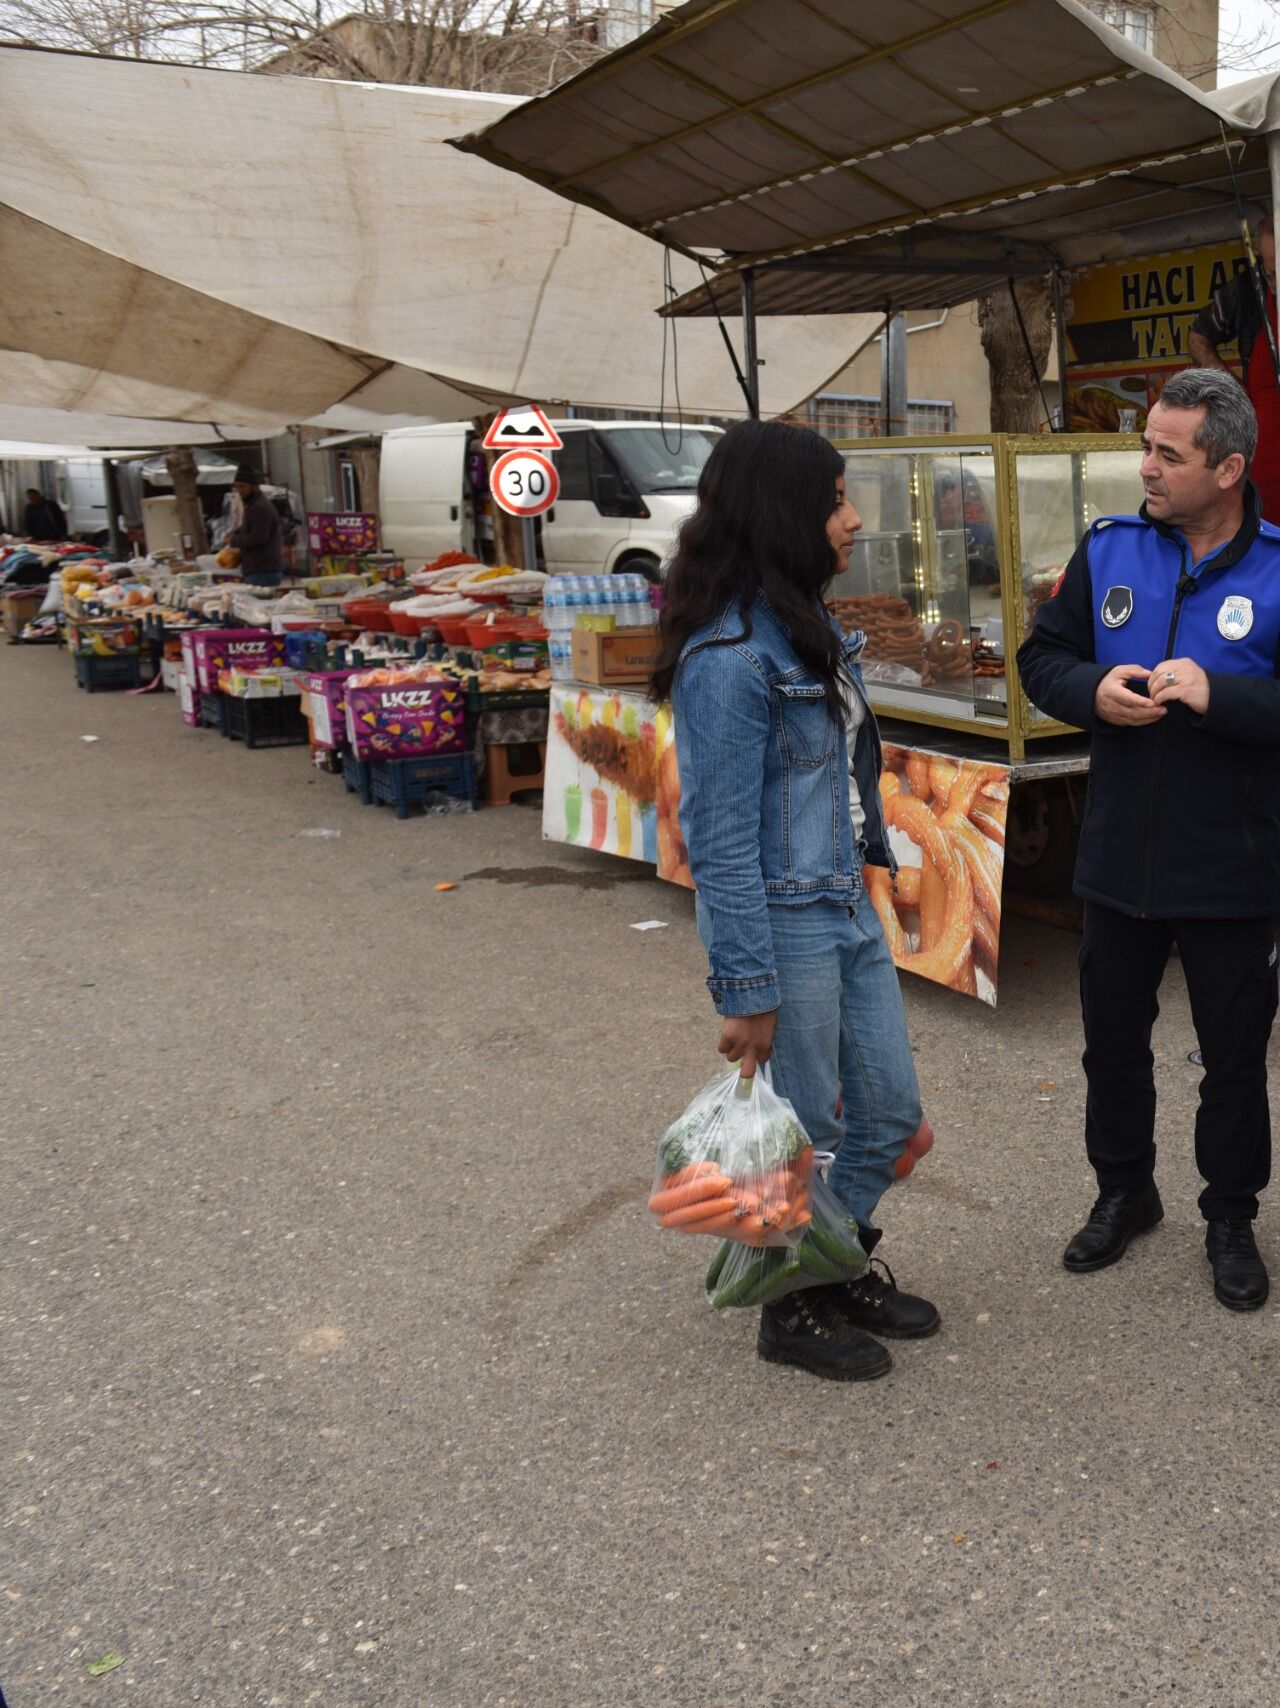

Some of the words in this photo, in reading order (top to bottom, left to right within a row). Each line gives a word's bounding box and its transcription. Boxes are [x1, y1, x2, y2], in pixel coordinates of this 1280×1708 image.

[1121, 265, 1196, 311] HACI
[1132, 313, 1198, 359] TAT
[508, 470, 545, 496] 30
[228, 641, 266, 654] LKZZ
[381, 690, 432, 708] LKZZ
